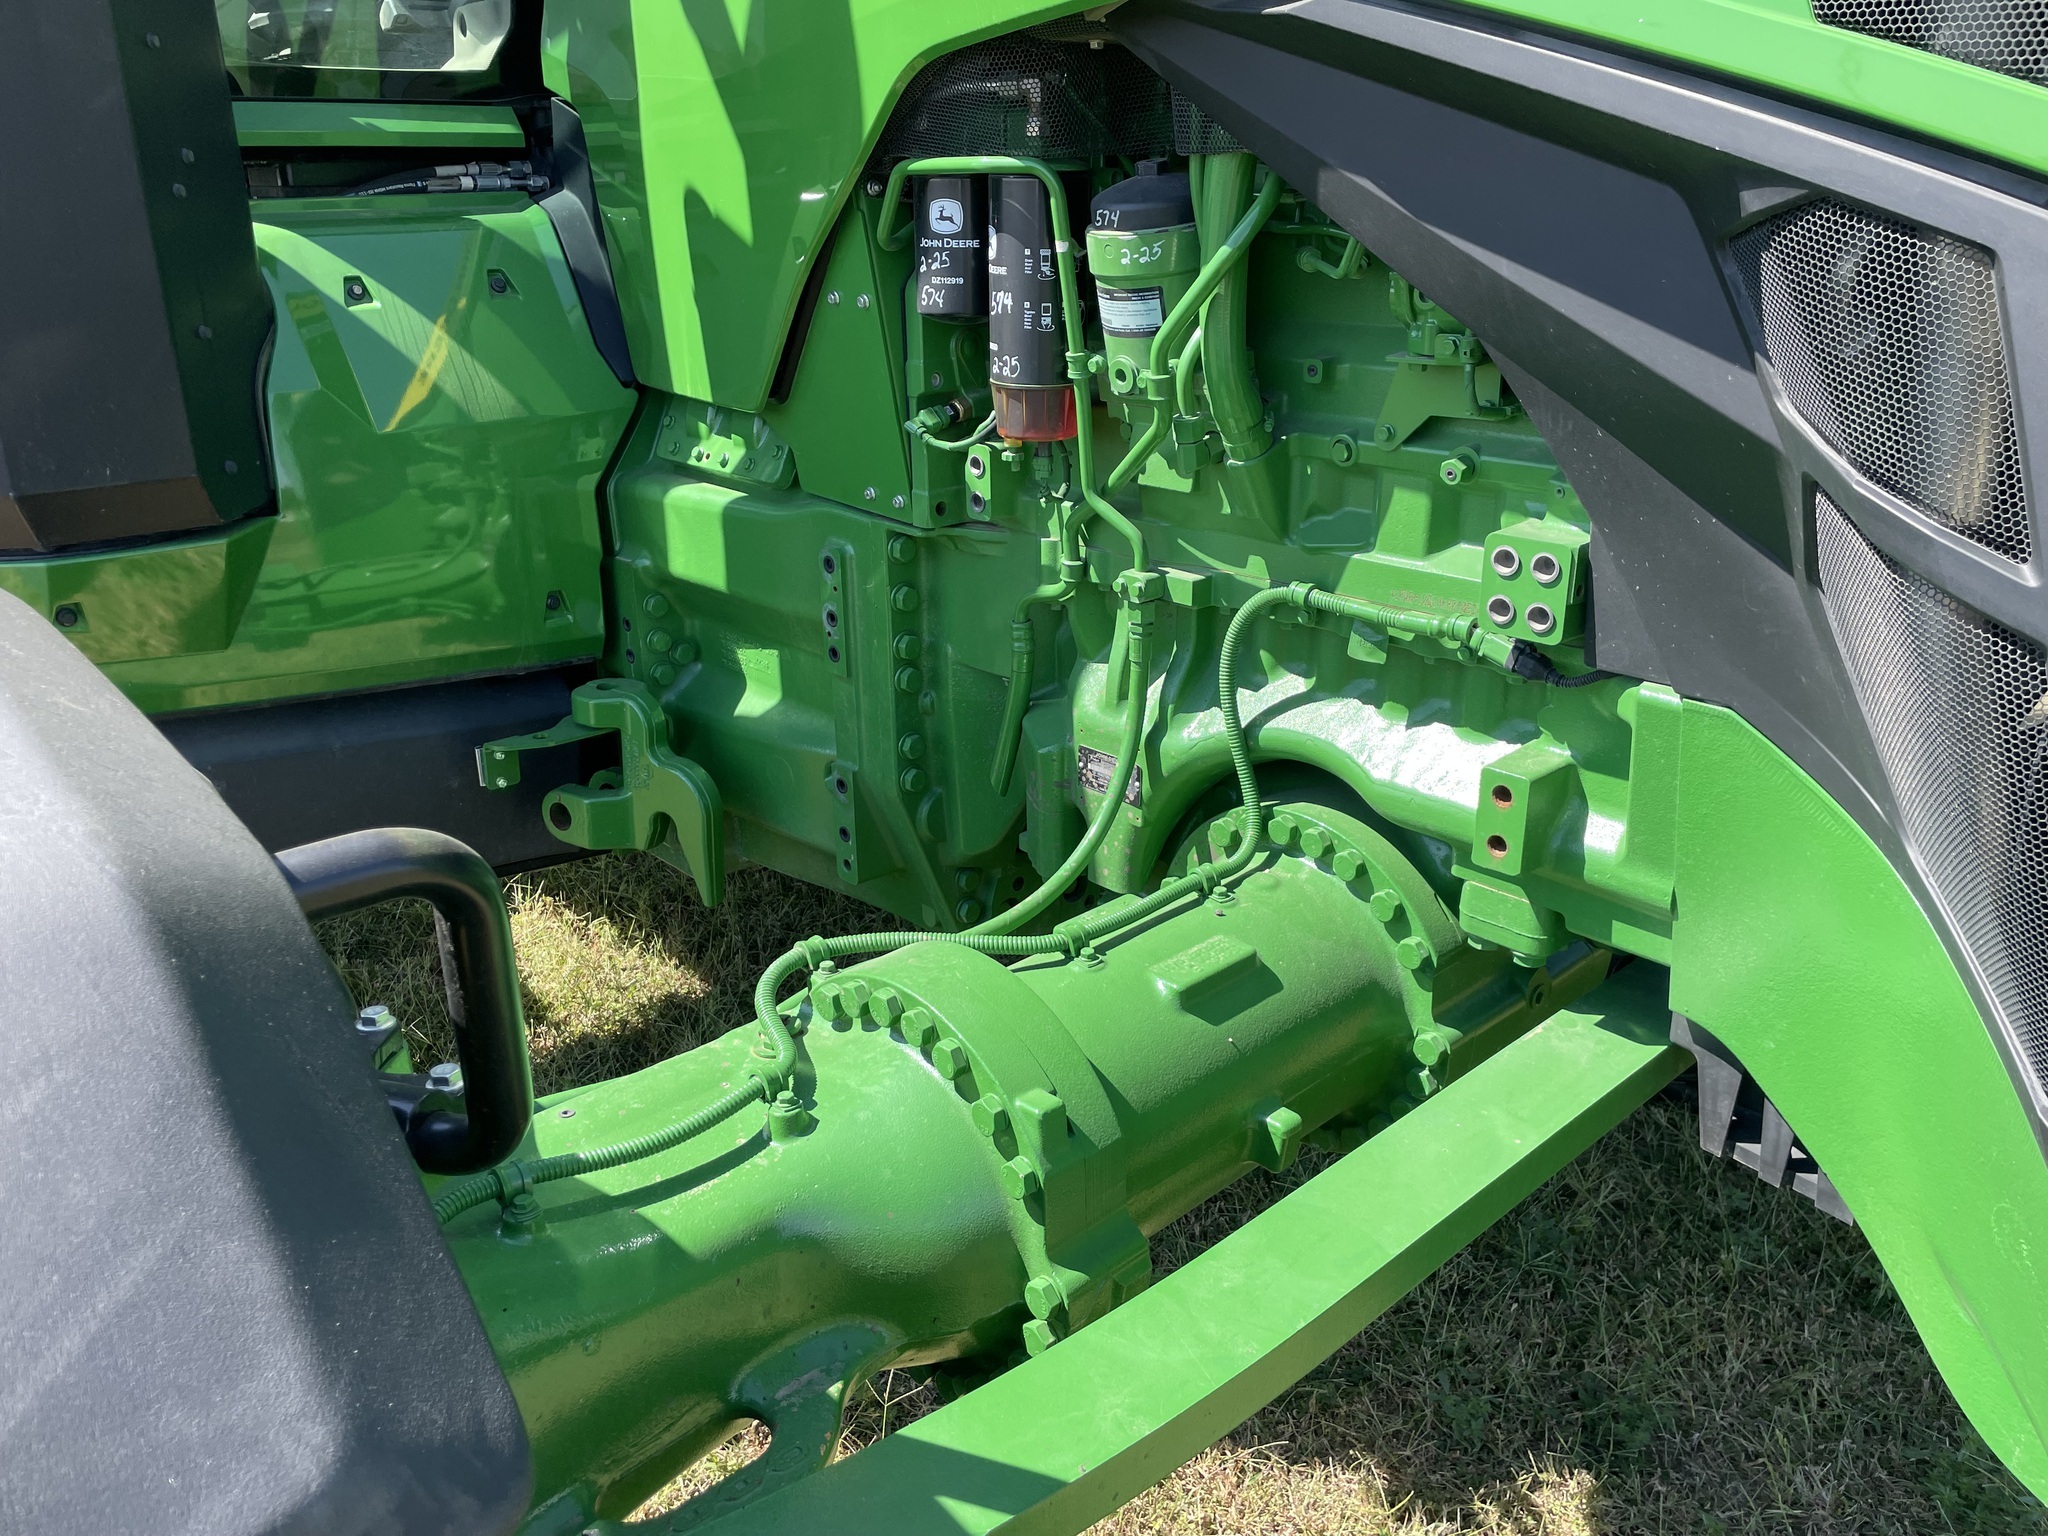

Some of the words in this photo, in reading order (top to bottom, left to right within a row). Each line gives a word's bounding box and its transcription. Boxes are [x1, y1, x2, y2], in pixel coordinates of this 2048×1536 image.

[1094, 209, 1120, 228] 574
[920, 237, 942, 248] JOHN
[943, 238, 980, 248] DEERE
[1120, 240, 1165, 265] 2-25
[931, 276, 964, 285] DZ112919
[921, 285, 945, 308] 574
[990, 290, 1013, 316] 574
[992, 355, 1020, 377] 2-25
